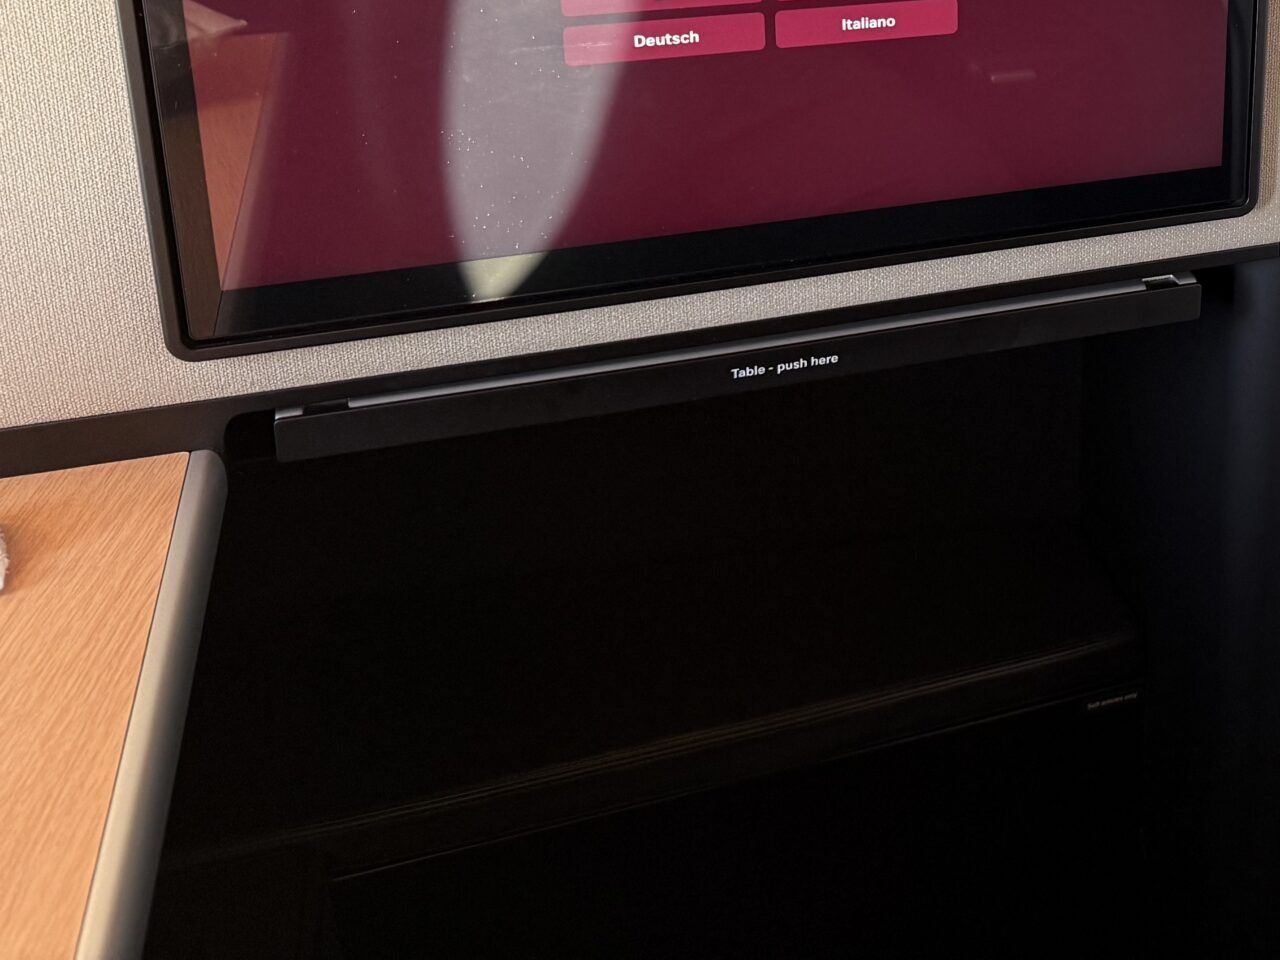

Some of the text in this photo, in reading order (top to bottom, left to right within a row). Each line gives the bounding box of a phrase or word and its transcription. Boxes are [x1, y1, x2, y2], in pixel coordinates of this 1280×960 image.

[841, 16, 896, 31] Italiano
[633, 30, 700, 48] Deutsch
[730, 365, 766, 379] Table
[776, 357, 808, 375] push
[810, 354, 839, 367] here
